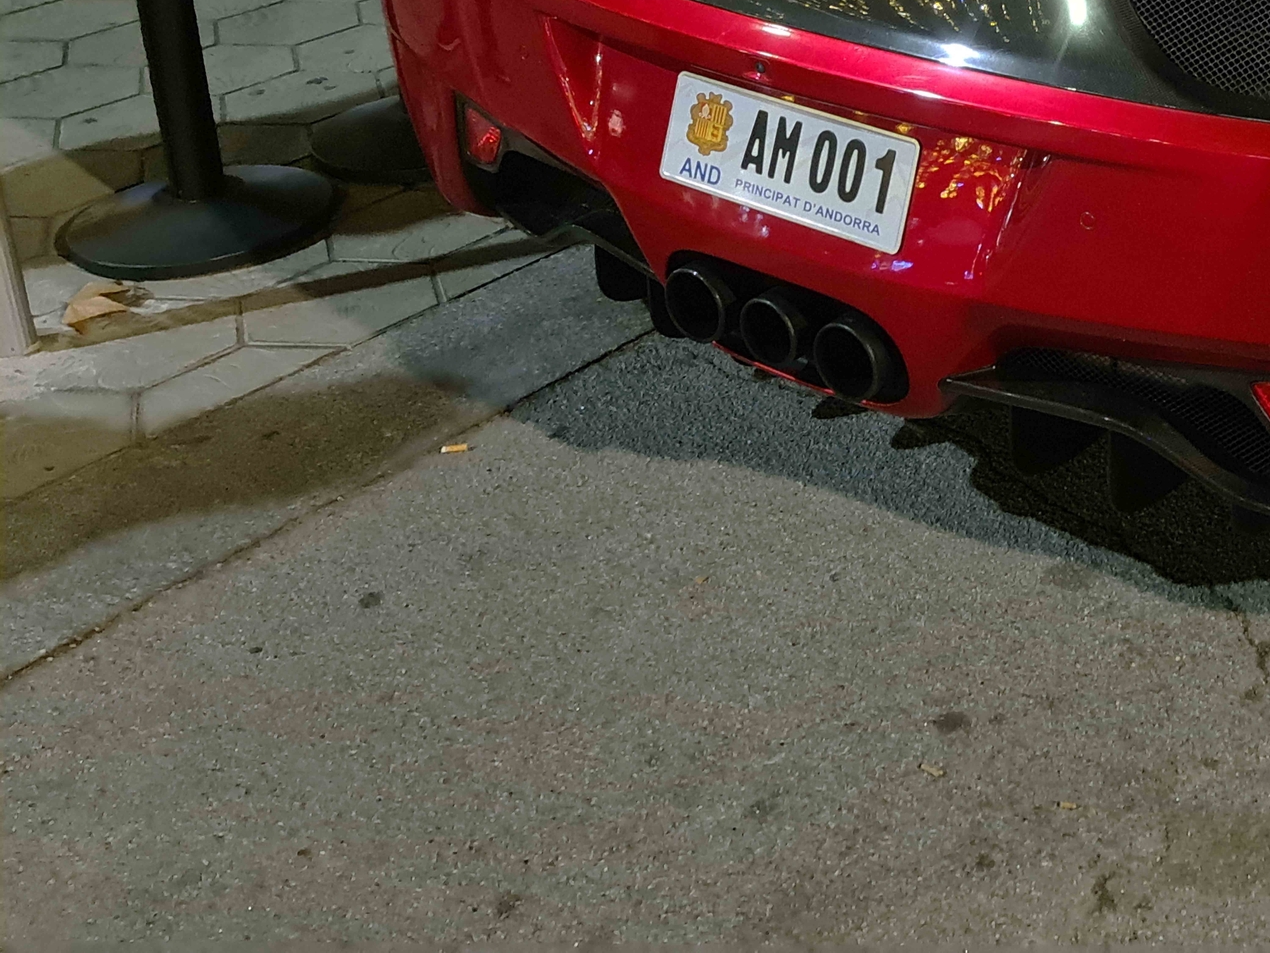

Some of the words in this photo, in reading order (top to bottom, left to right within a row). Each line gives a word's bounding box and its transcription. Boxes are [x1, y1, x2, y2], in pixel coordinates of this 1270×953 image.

[679, 157, 722, 186] AND
[740, 109, 803, 185] AM
[808, 129, 897, 215] 001
[734, 178, 801, 209] PRINCIPAT
[803, 201, 881, 237] D'ANDORRA
